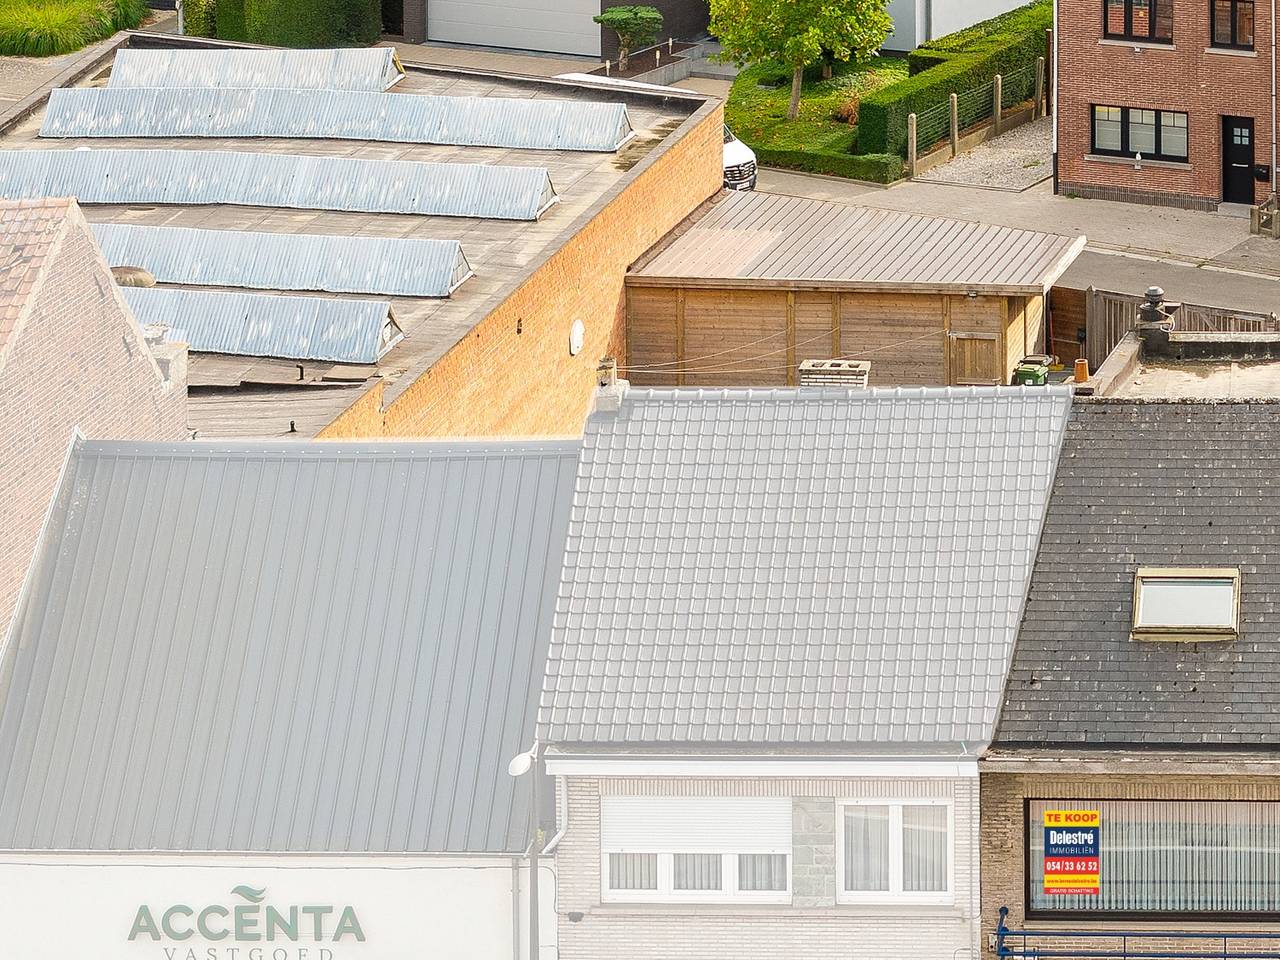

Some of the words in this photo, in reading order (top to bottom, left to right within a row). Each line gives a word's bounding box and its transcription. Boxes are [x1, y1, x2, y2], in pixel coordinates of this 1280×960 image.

[1047, 814, 1061, 822] TE
[1065, 814, 1097, 822] KOOP
[1050, 830, 1093, 844] Delestré
[1047, 861, 1074, 871] 054/33
[1076, 862, 1086, 870] 62
[1088, 862, 1097, 870] 52
[127, 905, 366, 941] ACCENTA
